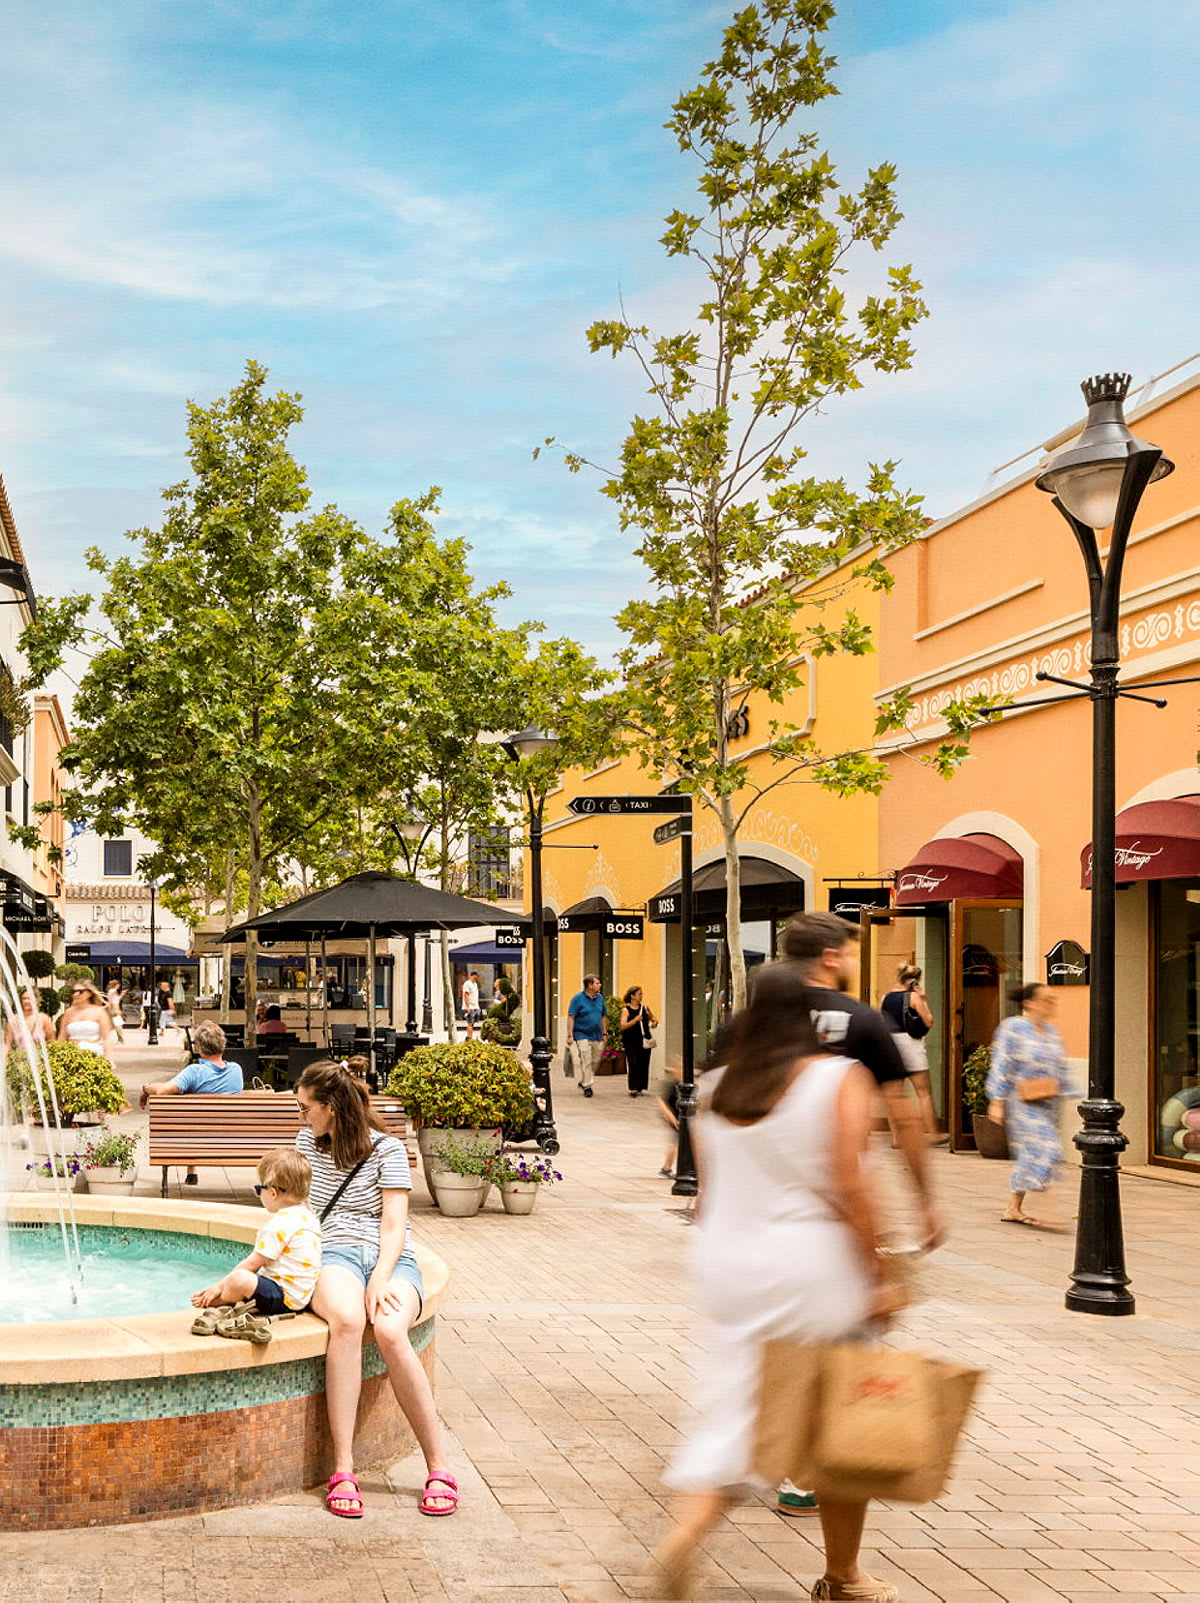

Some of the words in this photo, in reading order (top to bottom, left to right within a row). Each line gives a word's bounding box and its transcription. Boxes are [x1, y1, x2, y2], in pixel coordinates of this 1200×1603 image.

[629, 801, 649, 809] TAXI
[658, 897, 675, 914] BOSS
[92, 905, 145, 922] POLO
[606, 922, 641, 934] BOSS
